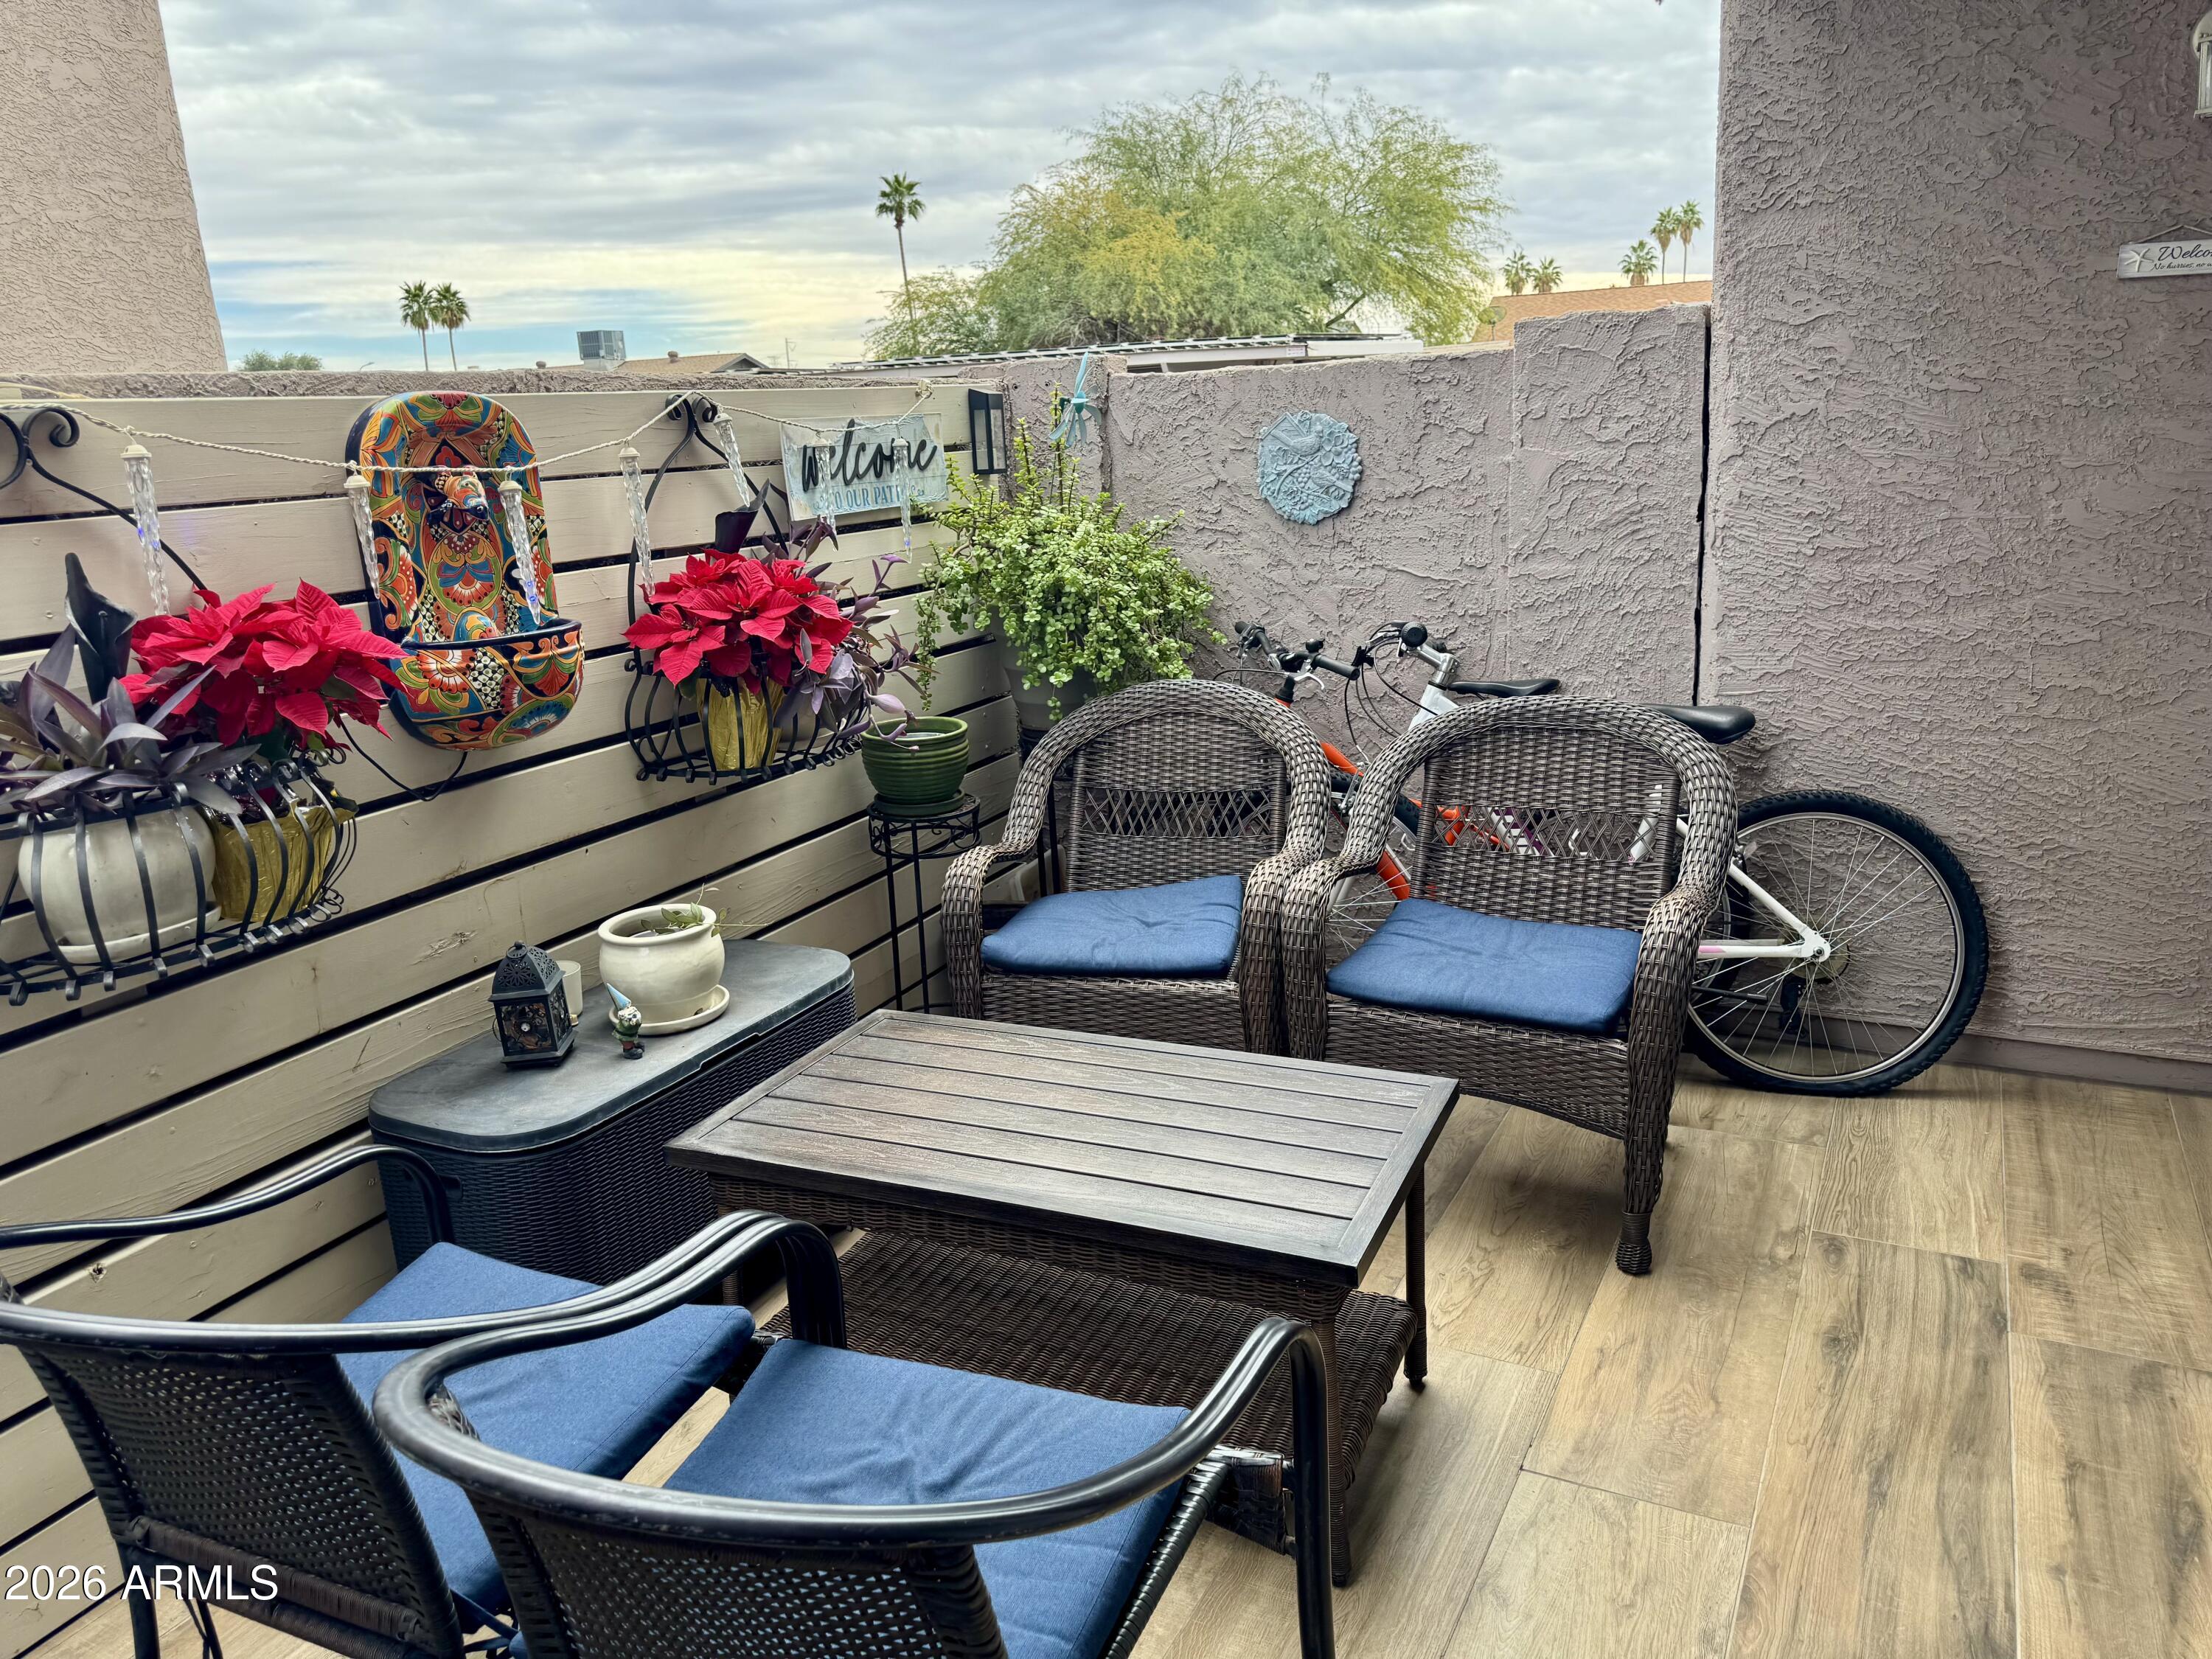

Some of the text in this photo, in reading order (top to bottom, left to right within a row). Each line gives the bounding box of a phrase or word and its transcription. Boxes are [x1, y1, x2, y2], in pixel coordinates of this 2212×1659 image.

[2157, 243, 2212, 262] Welco
[2150, 262, 2166, 271] No
[846, 487, 871, 509] OUR
[873, 484, 905, 506] PATI
